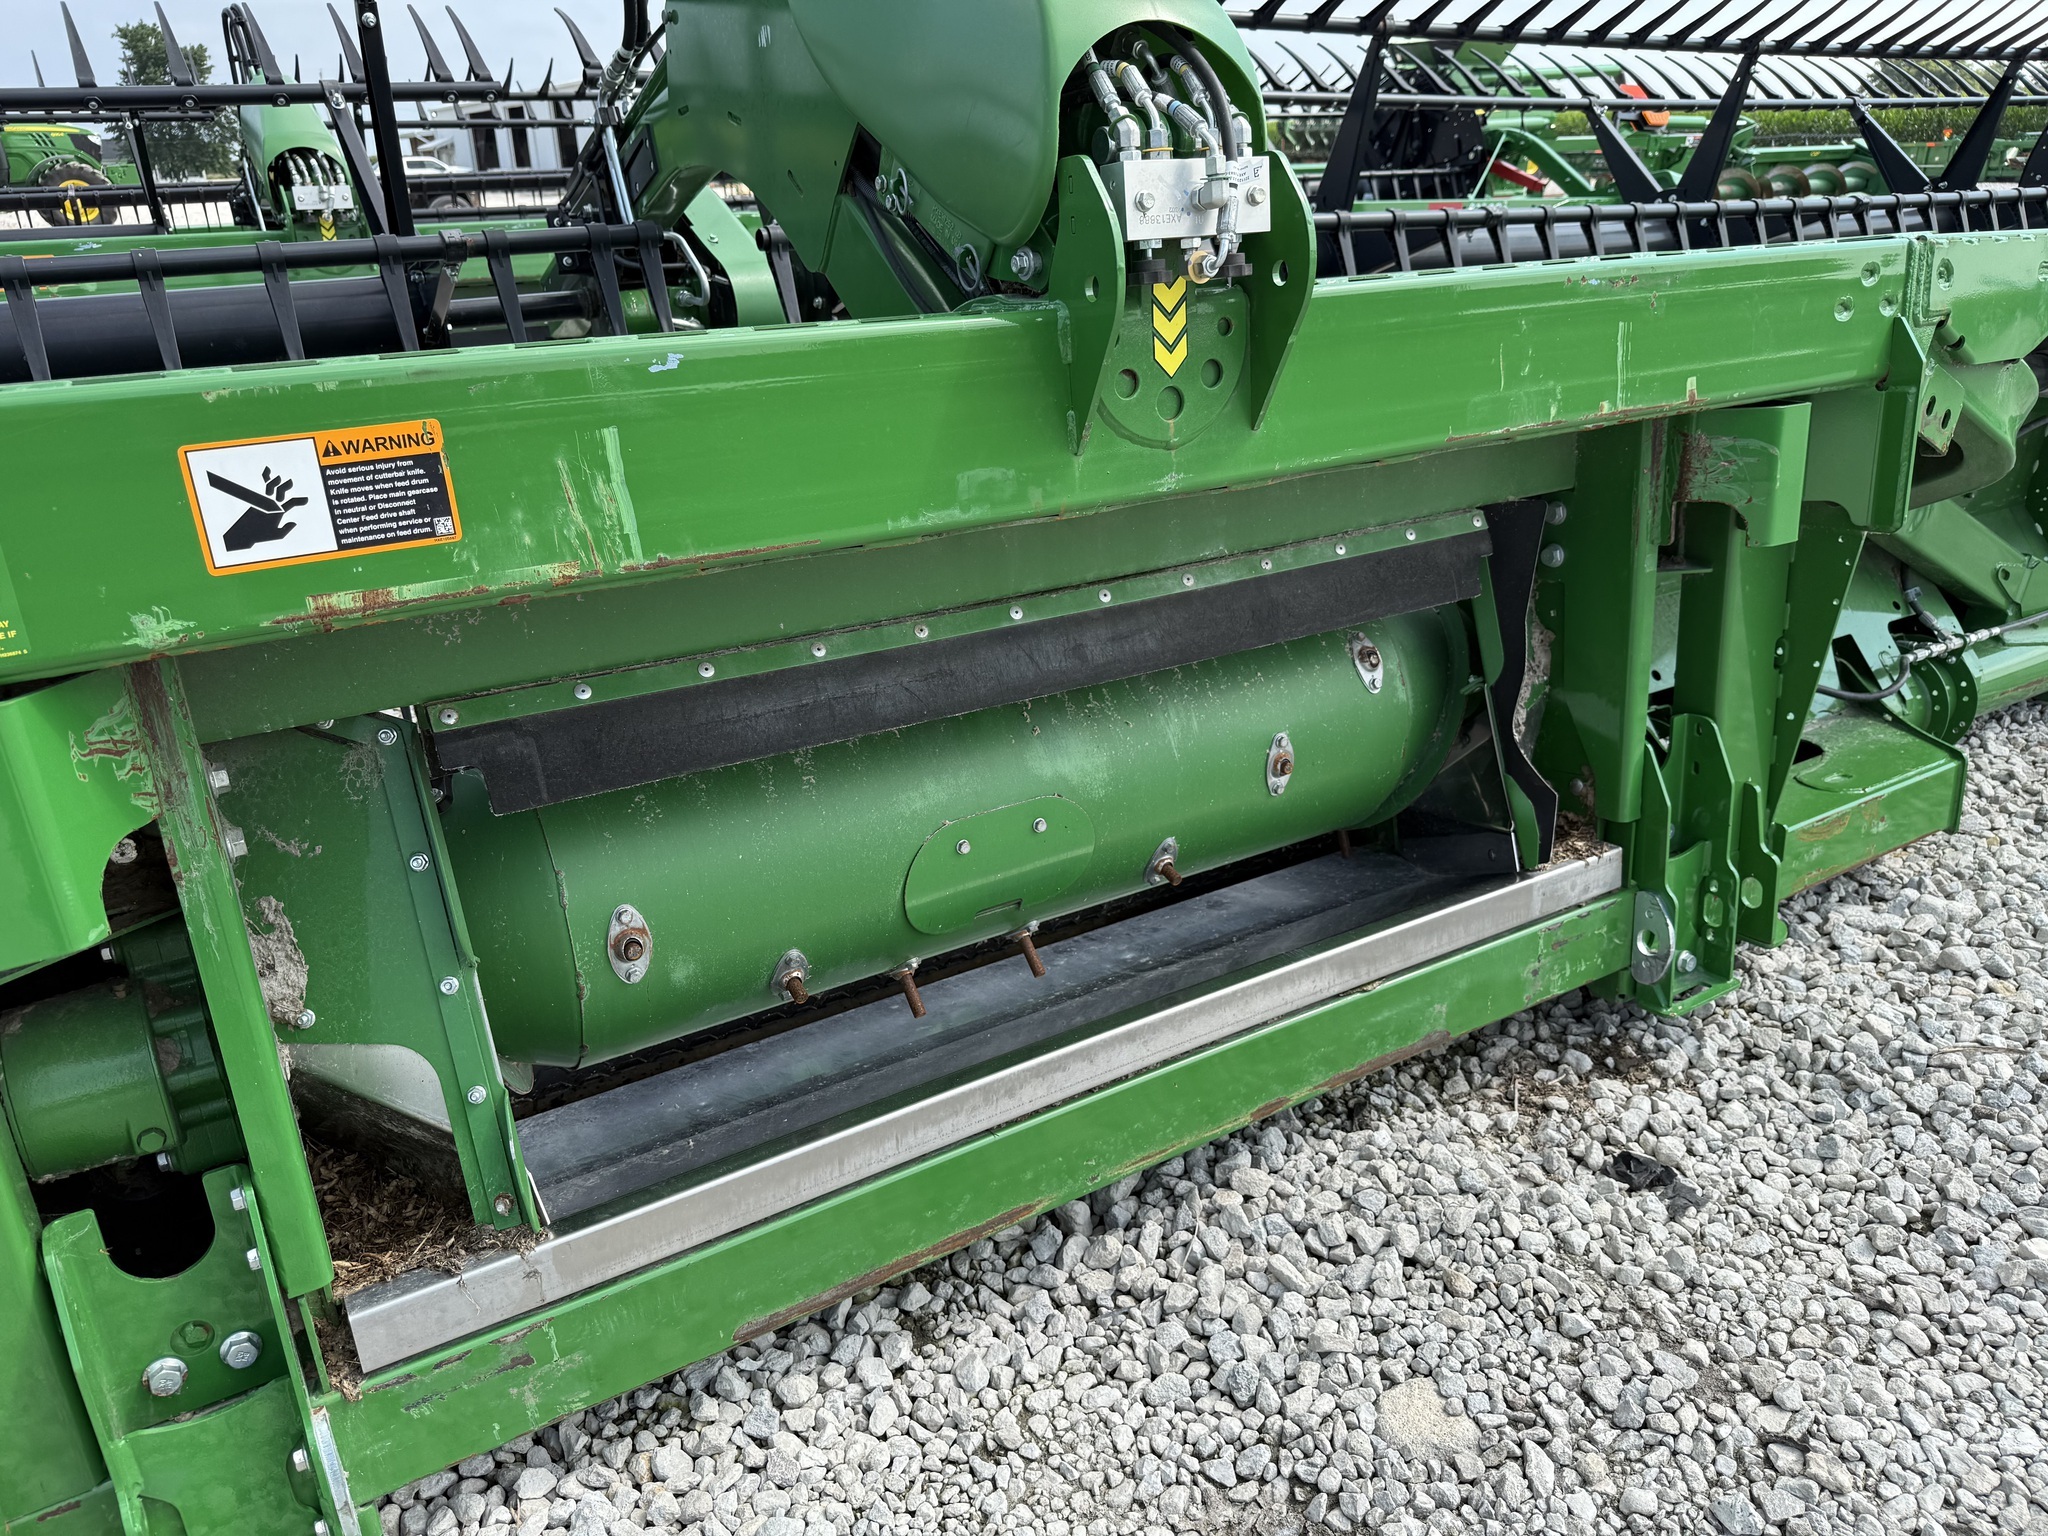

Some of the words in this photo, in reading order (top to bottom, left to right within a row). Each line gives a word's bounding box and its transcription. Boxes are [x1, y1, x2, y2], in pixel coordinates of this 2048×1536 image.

[340, 432, 435, 455] WARNING
[326, 468, 346, 476] Avoid
[348, 465, 375, 473] serious
[375, 462, 396, 471] injury
[328, 478, 365, 486] movement
[374, 470, 406, 480] cutterbar
[340, 495, 367, 504] rotated.
[407, 487, 438, 496] gearcase
[343, 505, 368, 514] neutral
[378, 499, 416, 509] Disconnect
[337, 516, 360, 525] Center
[339, 526, 358, 534] when
[360, 521, 398, 533] performing
[398, 518, 423, 526] service
[341, 534, 386, 544] maintenance
[412, 526, 432, 534] drum.
[8, 630, 16, 638] IF
